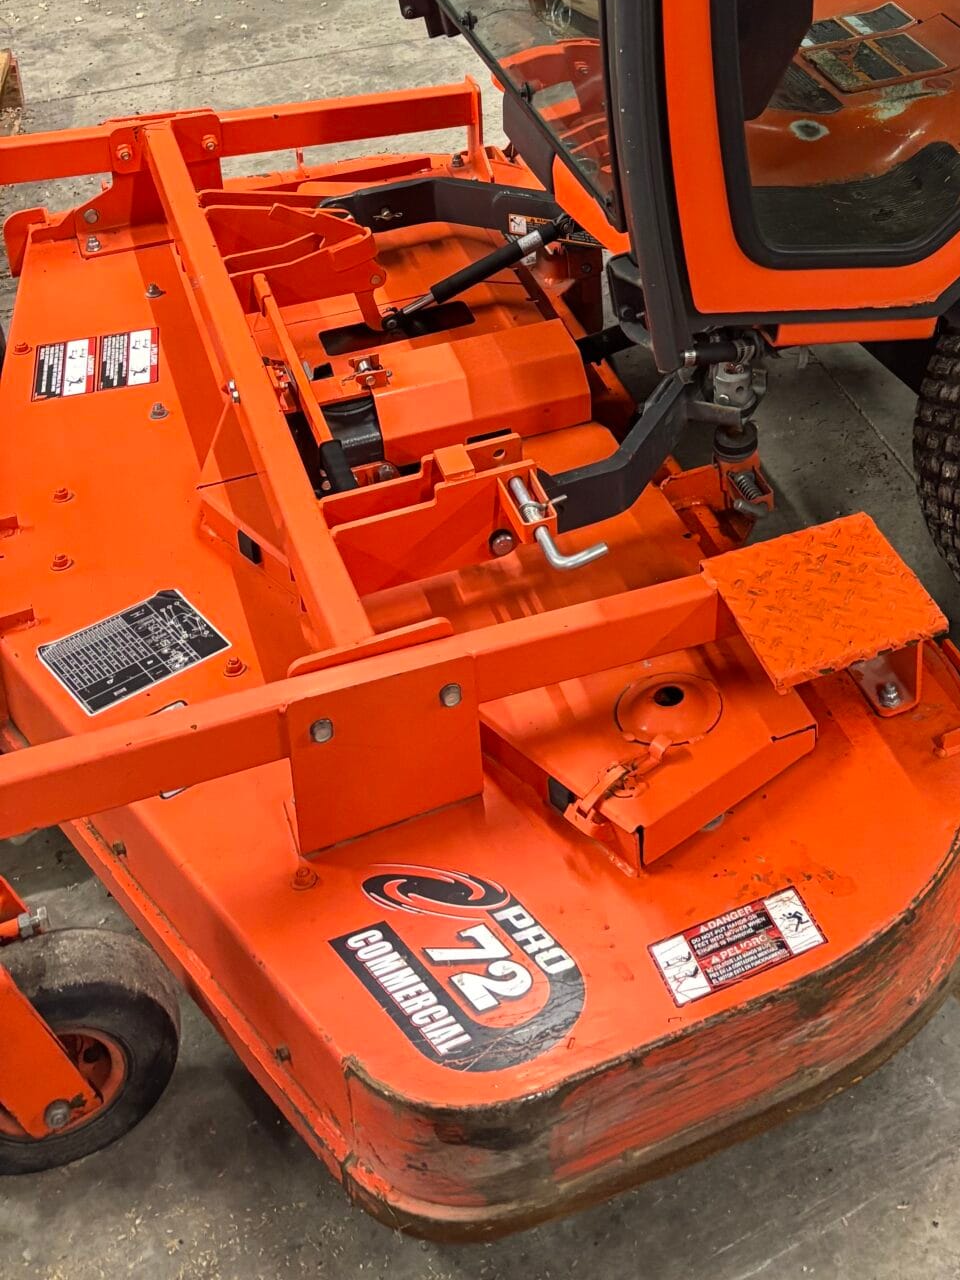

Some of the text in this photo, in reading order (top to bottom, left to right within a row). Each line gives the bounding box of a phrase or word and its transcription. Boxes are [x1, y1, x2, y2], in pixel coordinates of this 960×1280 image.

[492, 904, 577, 975] PRO
[691, 937, 701, 945] DO
[701, 931, 714, 940] NOT
[707, 905, 753, 930] DANGER
[421, 922, 534, 1013] 72
[720, 934, 768, 960] PELIGRO
[344, 928, 472, 1057] COMMERCIAL
